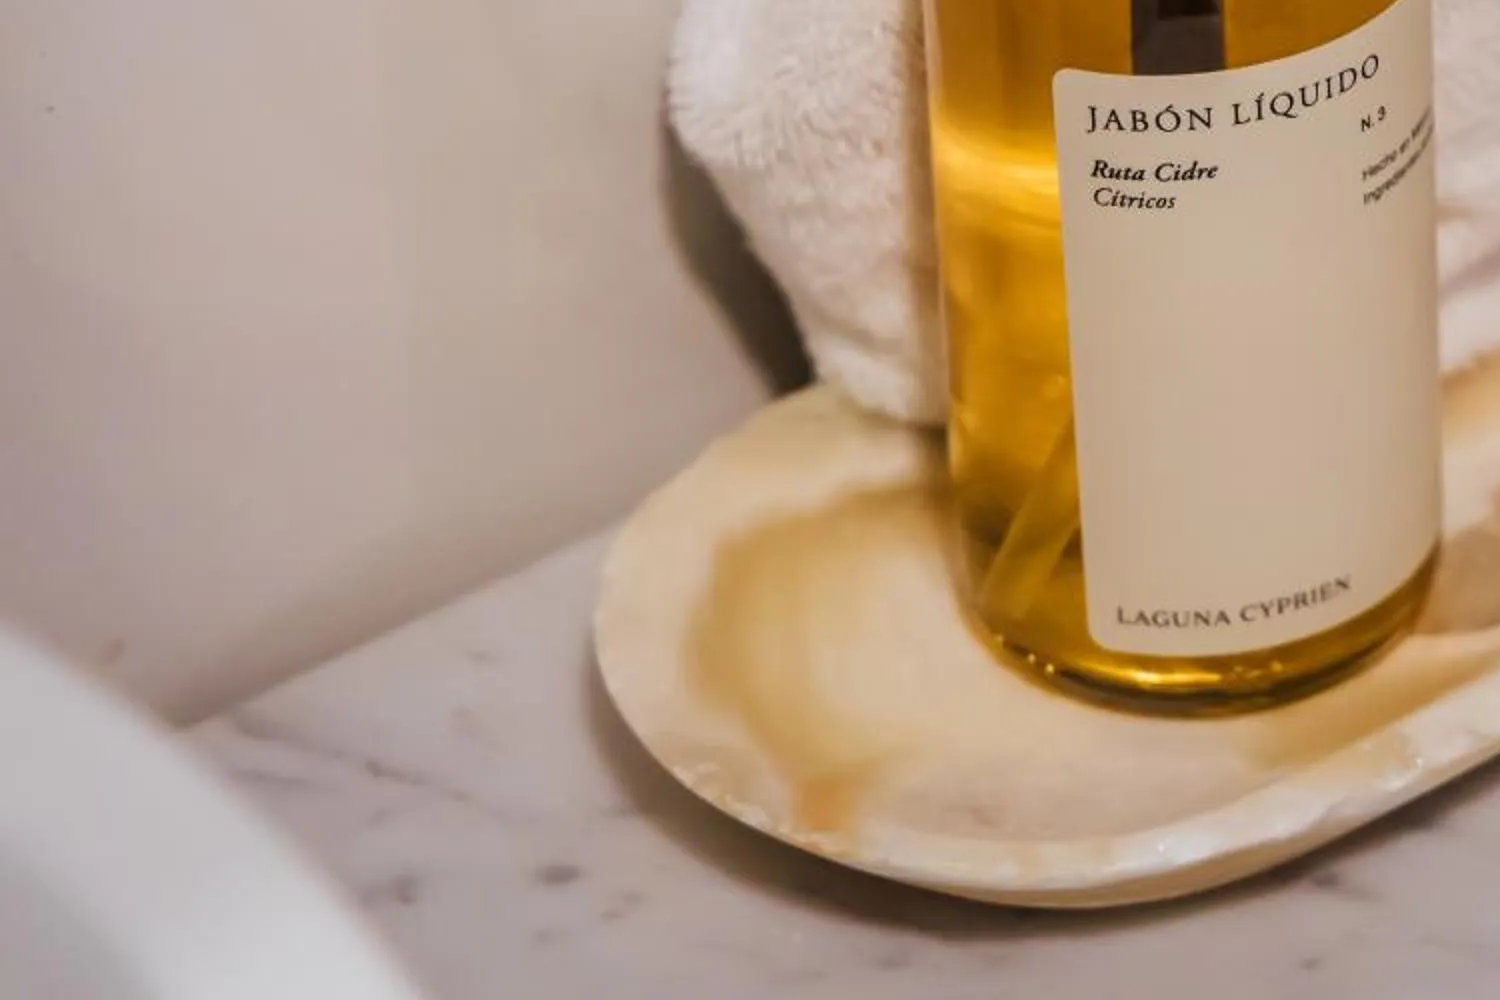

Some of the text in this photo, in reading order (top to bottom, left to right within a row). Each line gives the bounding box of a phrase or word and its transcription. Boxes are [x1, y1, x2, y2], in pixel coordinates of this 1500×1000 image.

[1086, 104, 1213, 134] JABÓN
[1230, 53, 1380, 127] LÍQUIDO
[1090, 158, 1219, 182] Ruta Cidre
[1092, 186, 1177, 210] Cítricos
[1116, 574, 1351, 628] LAGUNA CYPRIEN
